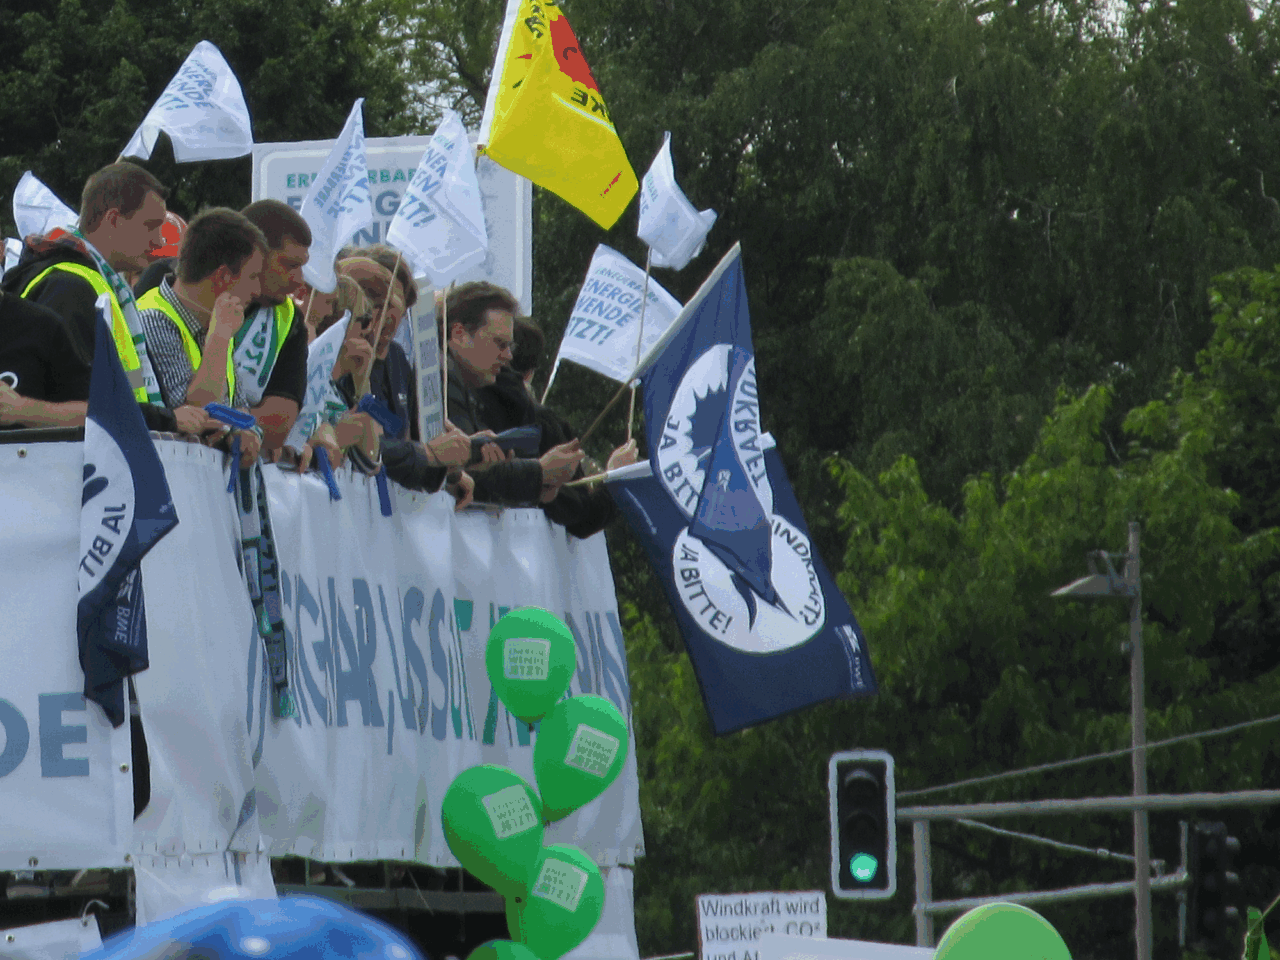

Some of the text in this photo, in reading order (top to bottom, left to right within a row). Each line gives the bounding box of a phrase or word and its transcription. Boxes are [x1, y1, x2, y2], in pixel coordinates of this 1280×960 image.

[680, 567, 734, 635] BITTE!
[701, 897, 820, 917] Windkraft wird
